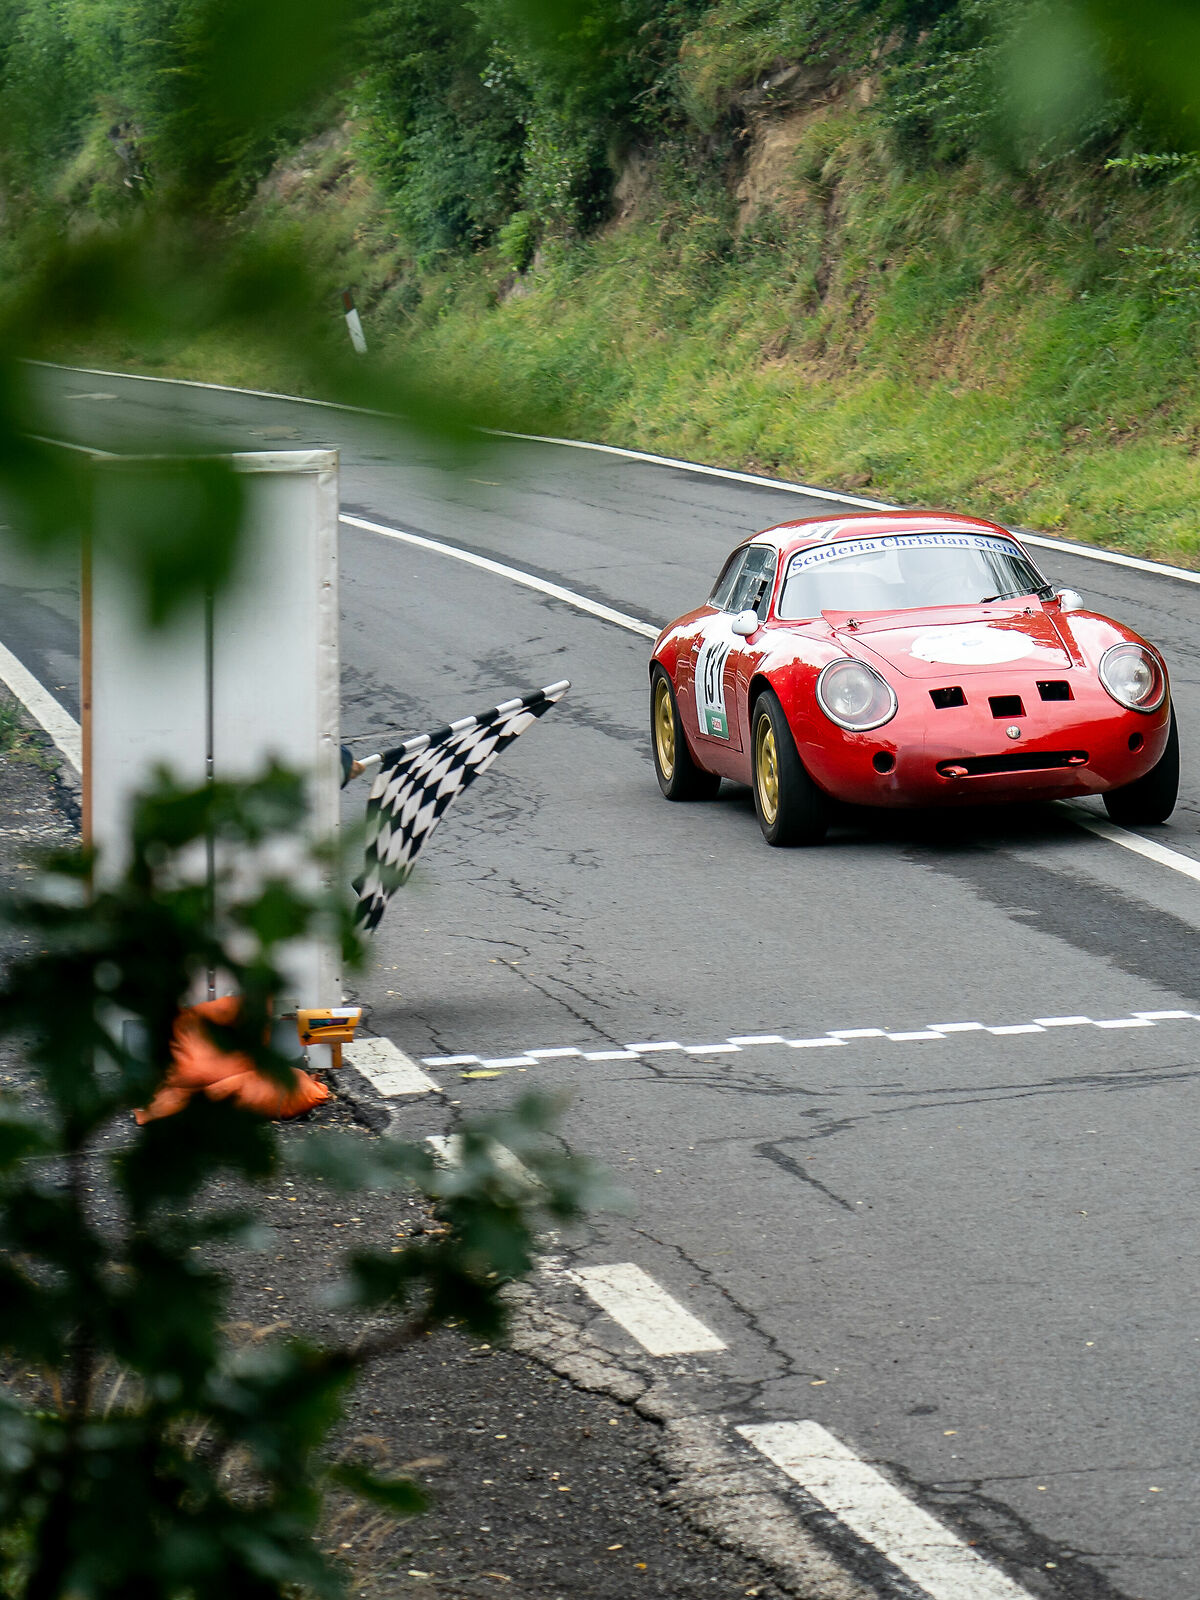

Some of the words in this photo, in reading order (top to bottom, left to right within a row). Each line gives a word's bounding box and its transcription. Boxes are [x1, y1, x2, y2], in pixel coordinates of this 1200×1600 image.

[792, 541, 876, 571] Scuderia
[881, 535, 970, 547] Christian
[974, 537, 1019, 556] Stein
